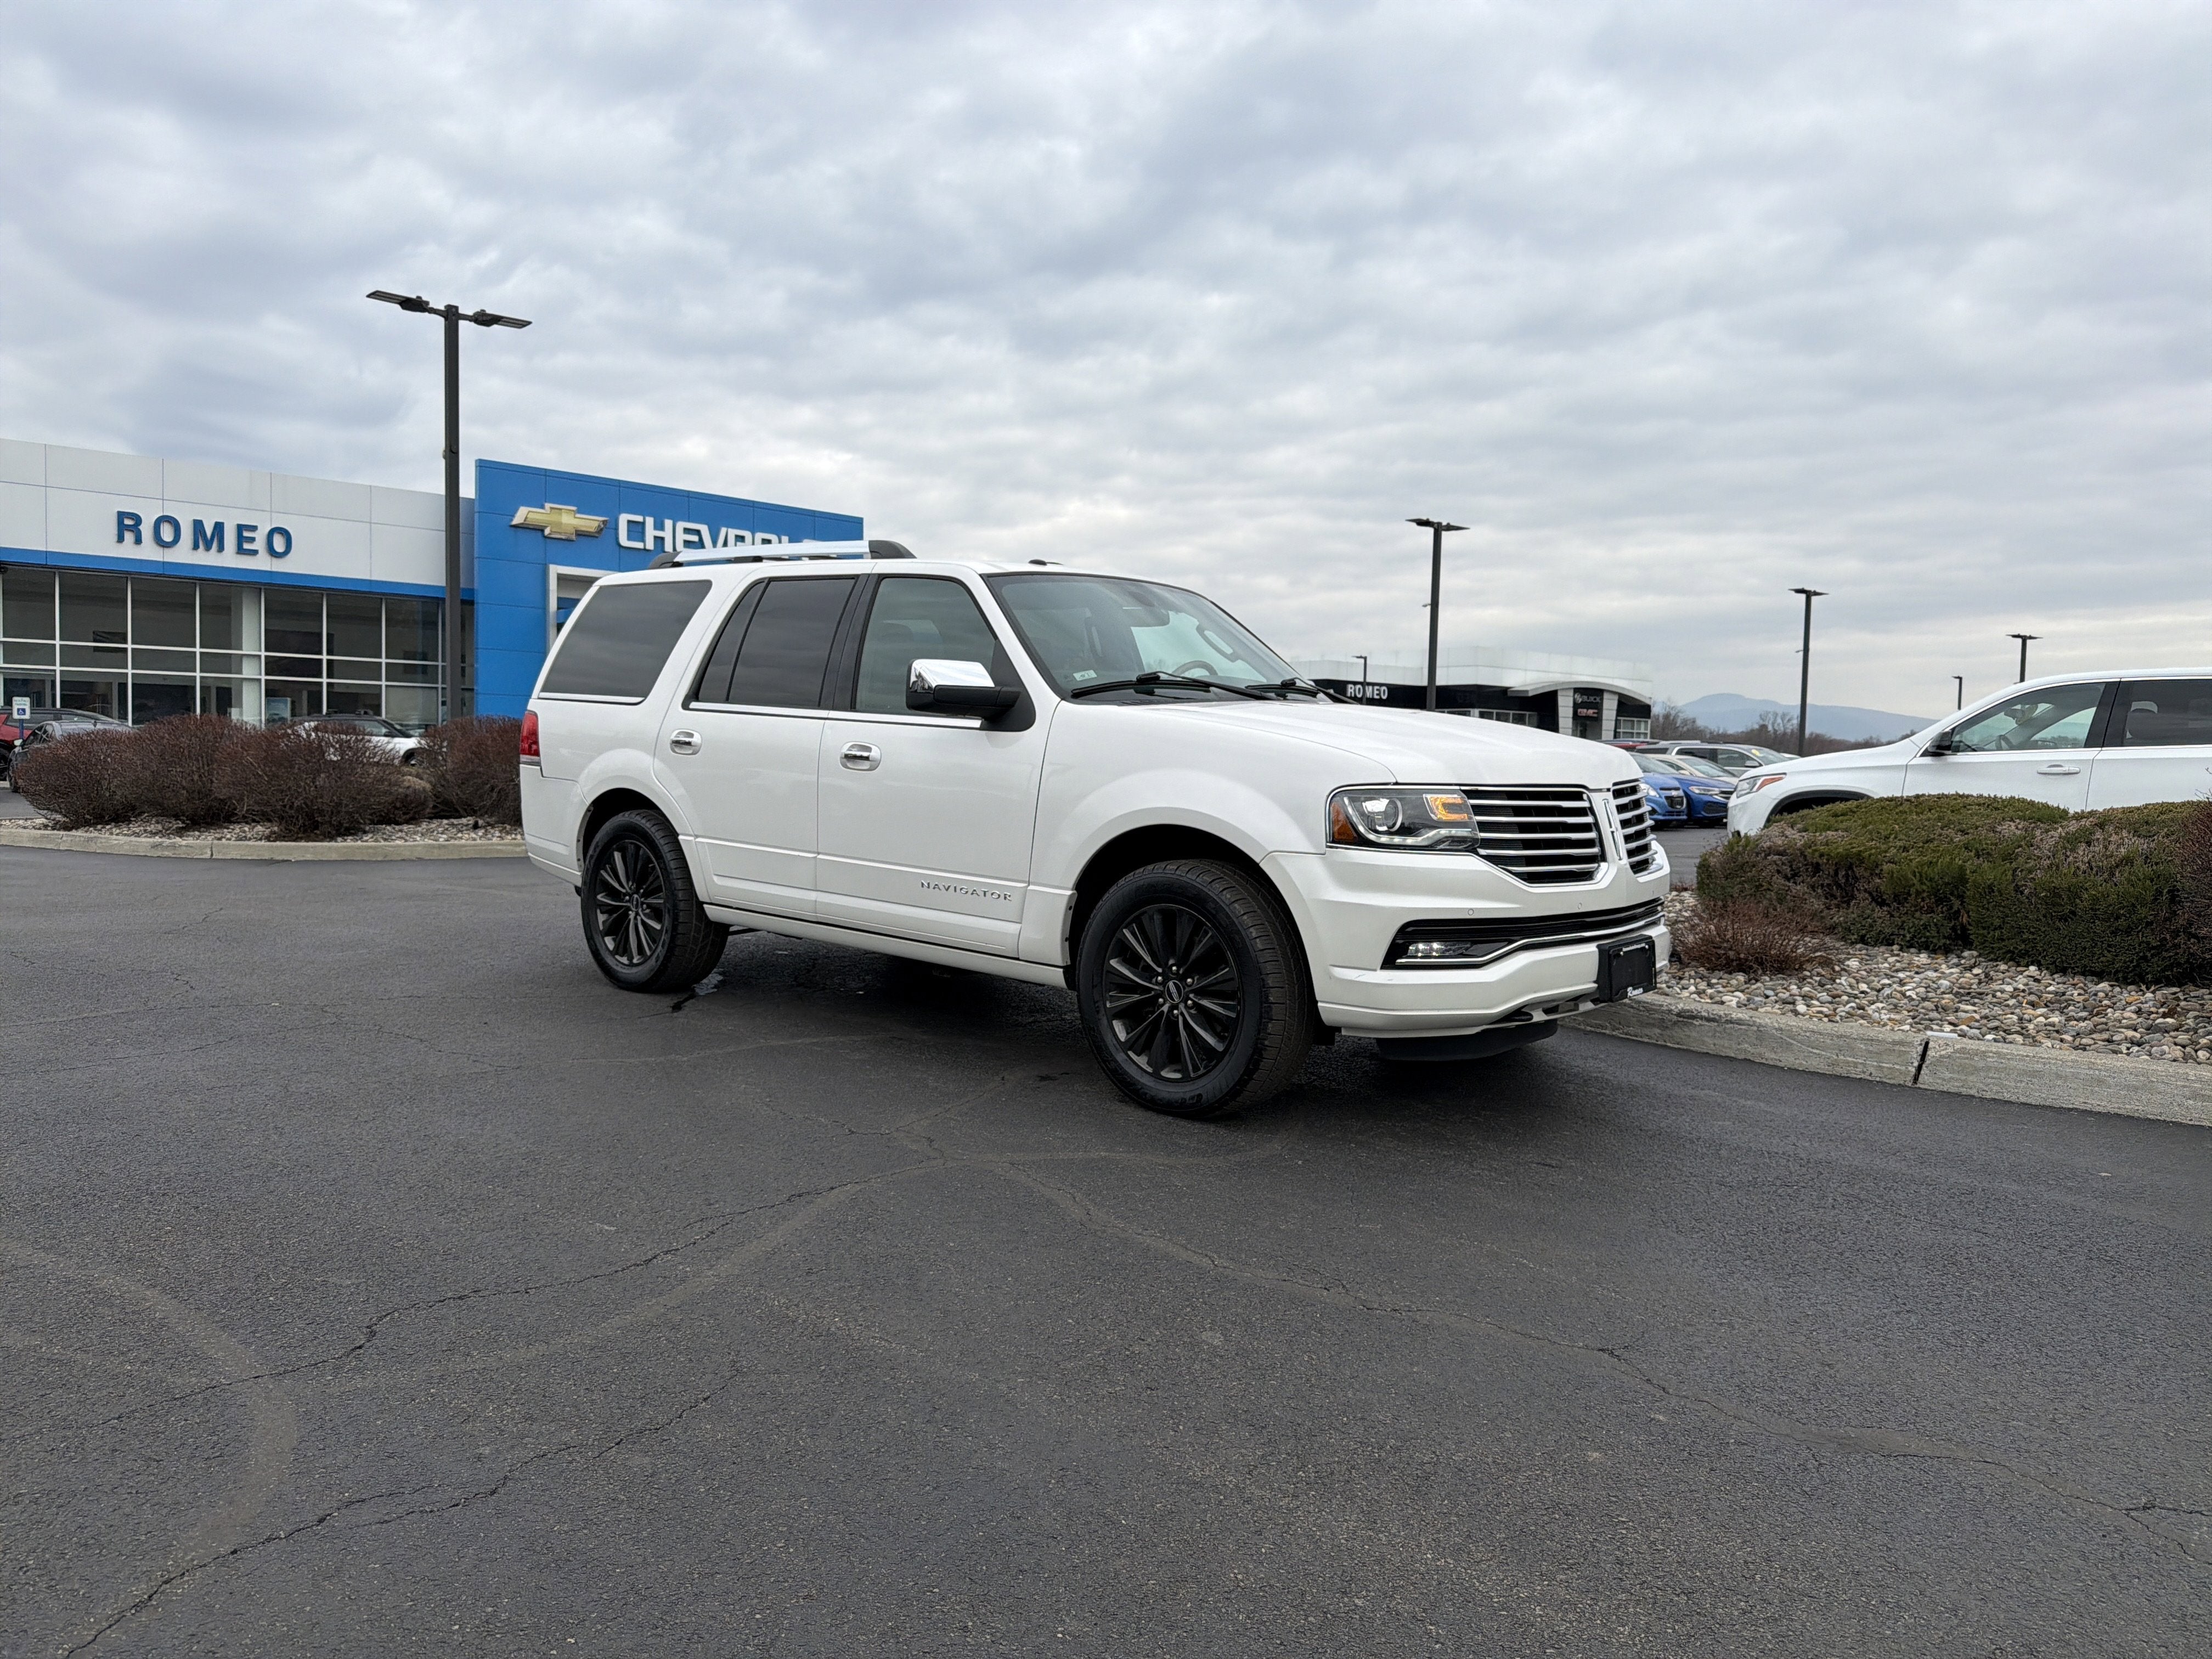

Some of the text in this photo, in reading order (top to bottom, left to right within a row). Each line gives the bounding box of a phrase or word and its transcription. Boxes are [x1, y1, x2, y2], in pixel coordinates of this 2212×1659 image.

[116, 510, 292, 558] ROMEO
[618, 513, 824, 552] CHEVR
[1346, 684, 1388, 699] ROMEO
[921, 880, 1012, 901] NAVIGATOR
